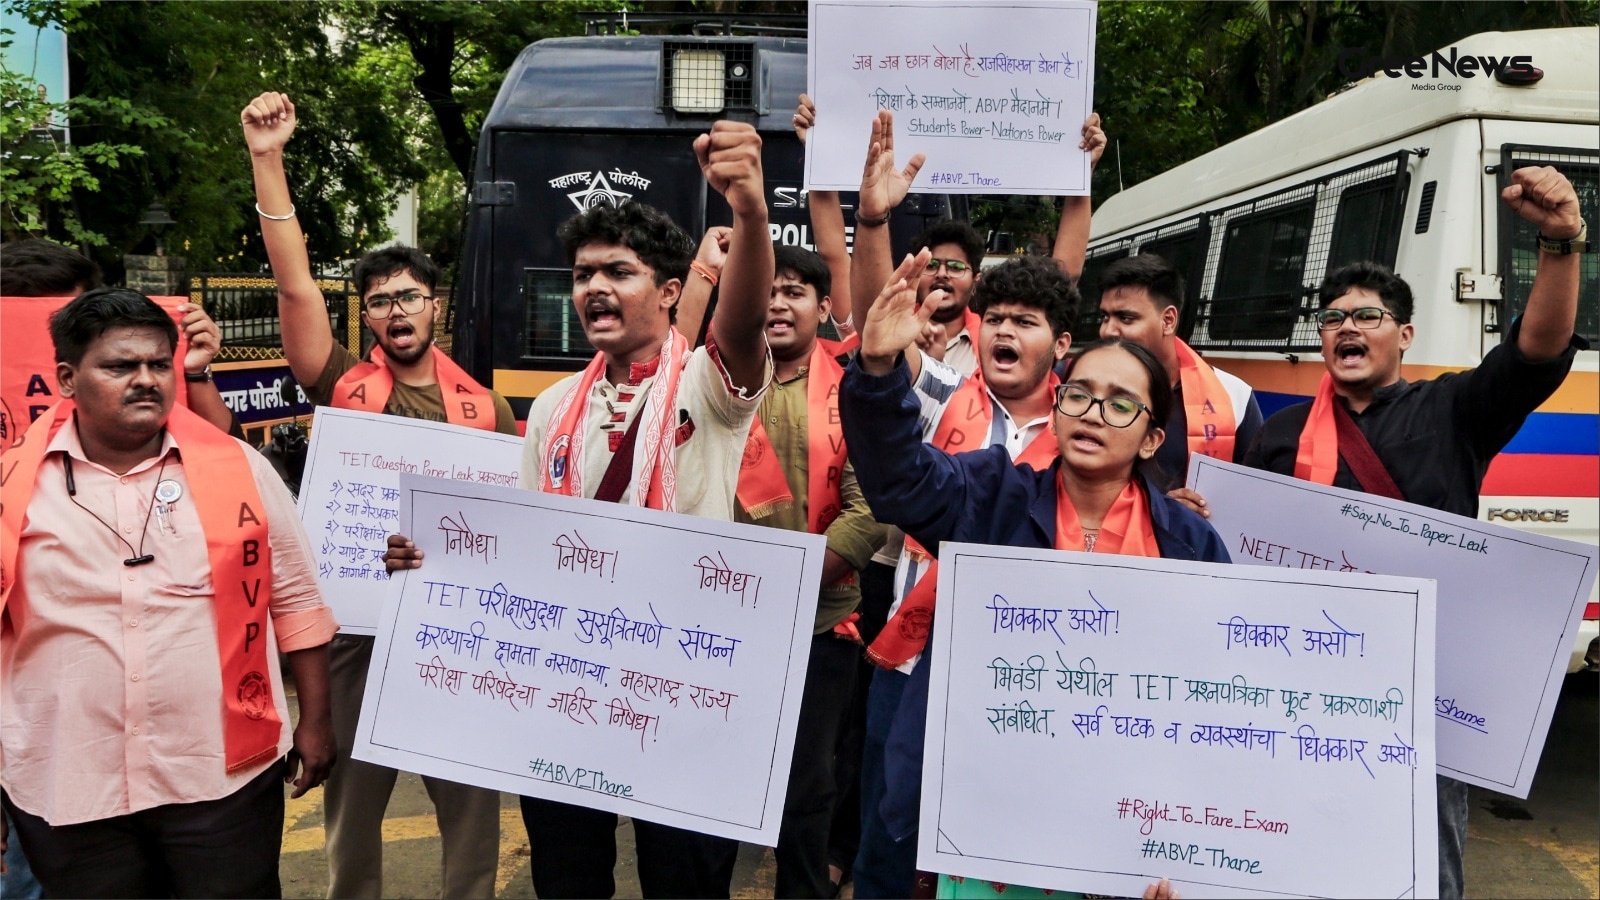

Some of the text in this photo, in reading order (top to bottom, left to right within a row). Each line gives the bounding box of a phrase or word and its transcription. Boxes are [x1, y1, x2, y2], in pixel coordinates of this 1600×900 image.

[878, 57, 899, 70] जब
[905, 55, 931, 69] छात्र
[933, 44, 962, 69] बोला
[977, 52, 1036, 75] राजसिंहासन
[1038, 52, 1065, 74] डोला
[905, 85, 919, 109] के
[975, 98, 1009, 114] ABVP
[908, 118, 956, 136] Student's
[1038, 129, 1067, 143] Power
[549, 167, 651, 191] महाराष्ट्र पोलीस
[930, 172, 1002, 187] #ABVP_Thane
[768, 223, 855, 254] POLE
[249, 379, 291, 410] पोली
[339, 451, 371, 468] TET
[371, 455, 418, 474] Question
[451, 464, 474, 481] Leak
[345, 503, 360, 516] या
[347, 482, 378, 500] सदर
[342, 521, 390, 543] परीक्षांचे
[1340, 503, 1488, 554] #Say_No_To_Paper_Leak
[1487, 507, 1570, 523] FORCE
[338, 541, 369, 564] यापुढे
[437, 511, 498, 565] निषेध!
[552, 529, 619, 583] निषेध!
[237, 501, 262, 653] ABVP
[338, 563, 372, 580] आगामी
[693, 551, 762, 609] निषेध!
[423, 580, 469, 609] TET
[574, 602, 672, 650] सुसूत्रितपणे
[678, 624, 742, 667] संपन्न
[985, 594, 1066, 645] धिक्कार
[1068, 589, 1119, 636] असो!
[1217, 609, 1365, 658] धिक्कार असो!
[416, 621, 489, 661] करण्याची
[495, 639, 540, 670] क्षमता
[620, 667, 684, 709] महाराष्ट्र
[689, 683, 739, 721] राज्य
[986, 650, 1404, 724] भिवंडी येथील TET प्रश्नपत्रिका फूट प्रकरणाशी
[416, 655, 659, 752] परीक्षा परिषदेचा जाहीर निषेध!
[1071, 704, 1109, 738] सर्व
[1110, 715, 1155, 739] घटक
[1163, 721, 1182, 745] व
[1190, 721, 1287, 759] व्यवस्थांचा
[1290, 724, 1376, 780] धिक्कार
[1377, 732, 1418, 770] असो!
[529, 757, 634, 797] #ABVP_Thane
[1116, 797, 1289, 836] #Right_To_Fare_Exam
[1141, 838, 1263, 875] #ABVP_Thane
